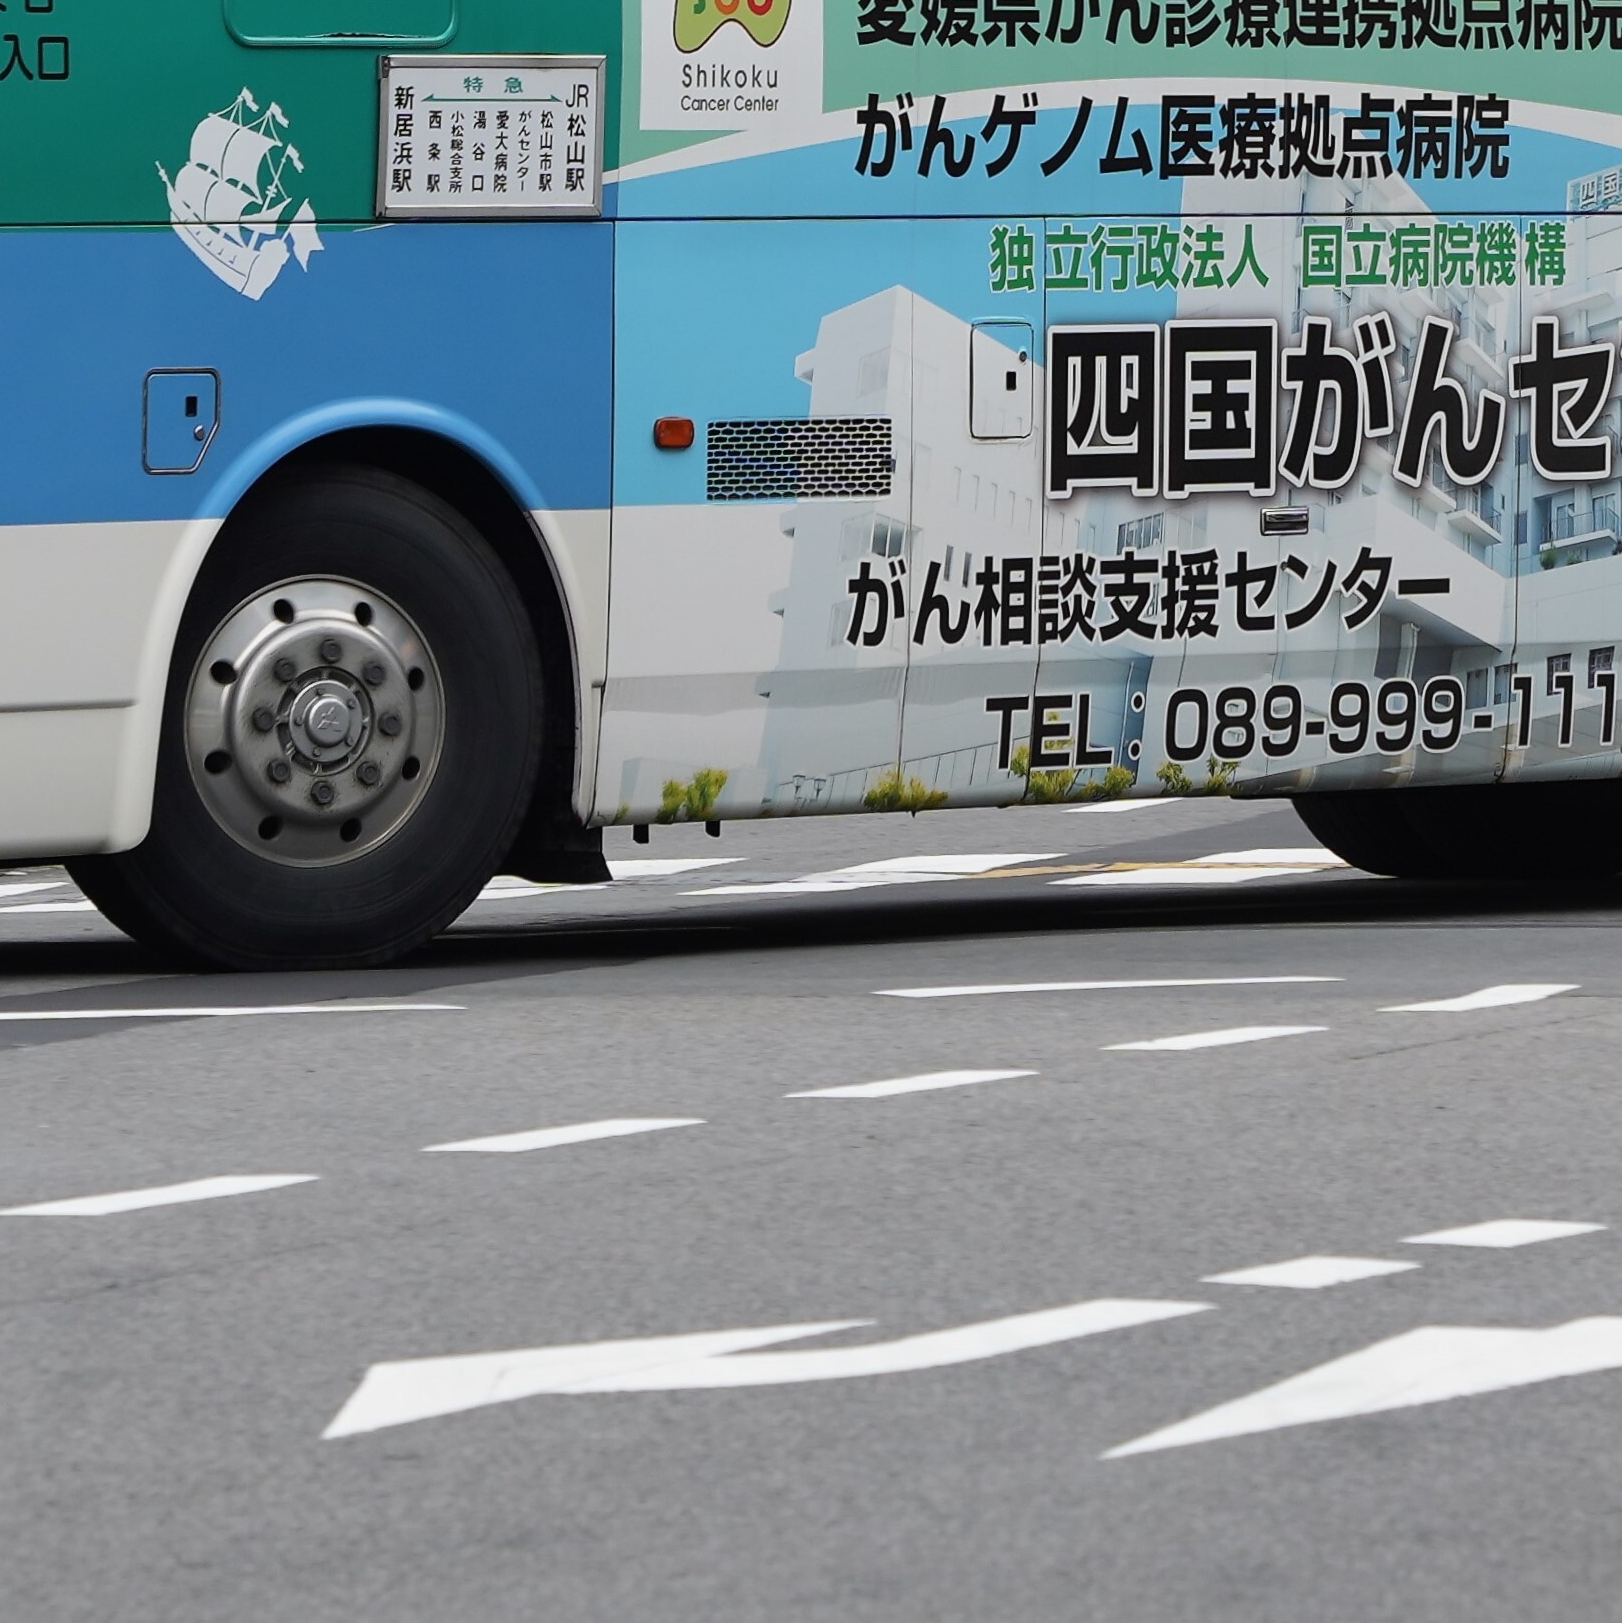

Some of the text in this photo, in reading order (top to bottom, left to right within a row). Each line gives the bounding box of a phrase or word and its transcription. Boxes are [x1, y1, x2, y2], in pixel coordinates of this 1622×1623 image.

[463, 76, 524, 94] 特急
[681, 63, 778, 89] Shikoku
[681, 95, 779, 112] Cancer Center
[390, 85, 414, 193] 新居浜駅
[426, 110, 442, 193] 西条駅
[448, 110, 465, 194] 小松総合支所
[471, 110, 487, 192] 湯谷口
[493, 110, 510, 193] 愛大病院
[516, 110, 532, 192] がんセンター
[538, 110, 554, 192] 松山市駅
[564, 84, 590, 193] JR松山駅
[855, 92, 1509, 180] がんゲノム医療拠点病院
[989, 222, 1567, 293] 独立行政法人 国立病院機構
[844, 546, 1452, 648] がん相談支援センター
